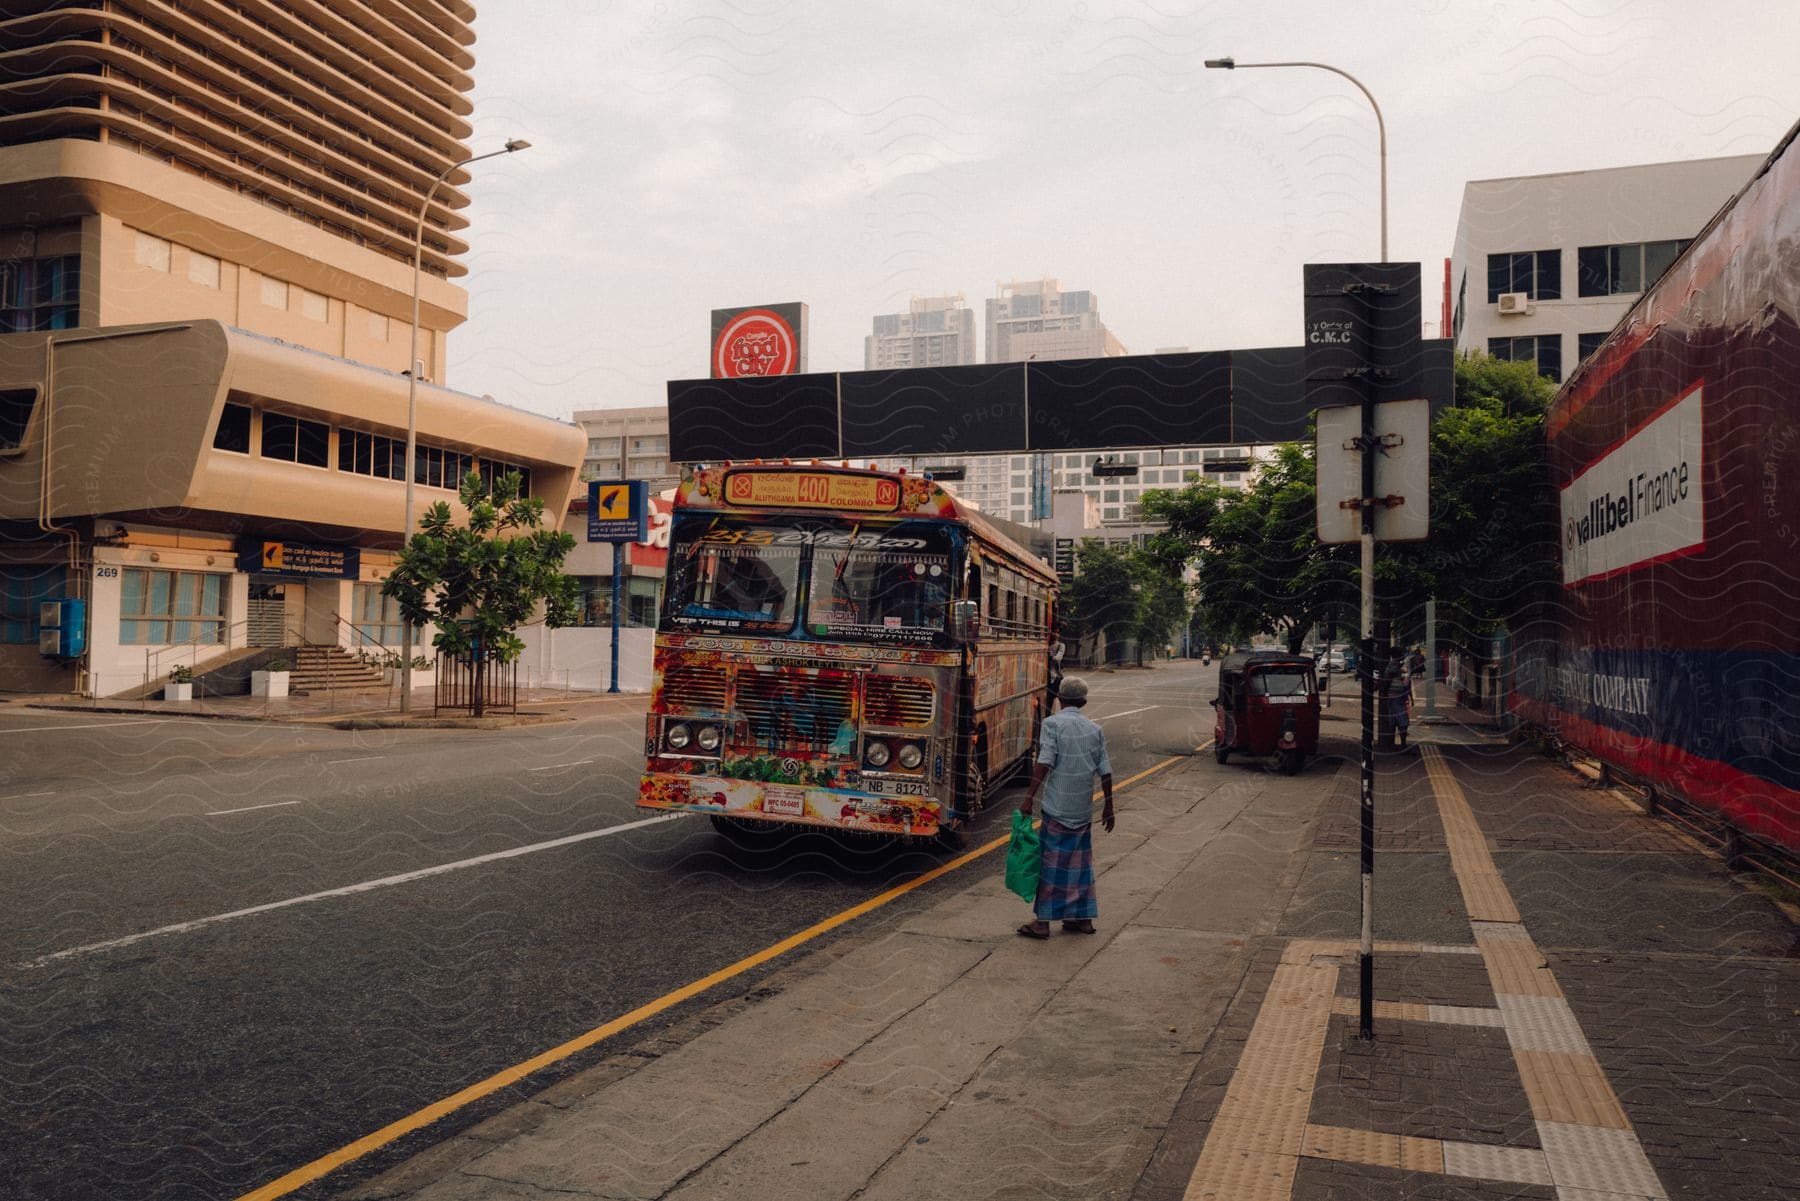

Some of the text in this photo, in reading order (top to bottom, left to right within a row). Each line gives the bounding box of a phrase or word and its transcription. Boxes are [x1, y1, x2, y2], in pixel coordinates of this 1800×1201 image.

[731, 333, 779, 362] food
[799, 477, 829, 502] 400
[830, 497, 874, 507] COLOMBO
[1576, 461, 1689, 546] vallibel Finance
[97, 567, 118, 578] 269
[1592, 674, 1650, 715] COMPANY
[868, 781, 883, 792] NB
[895, 783, 922, 795] 8121
